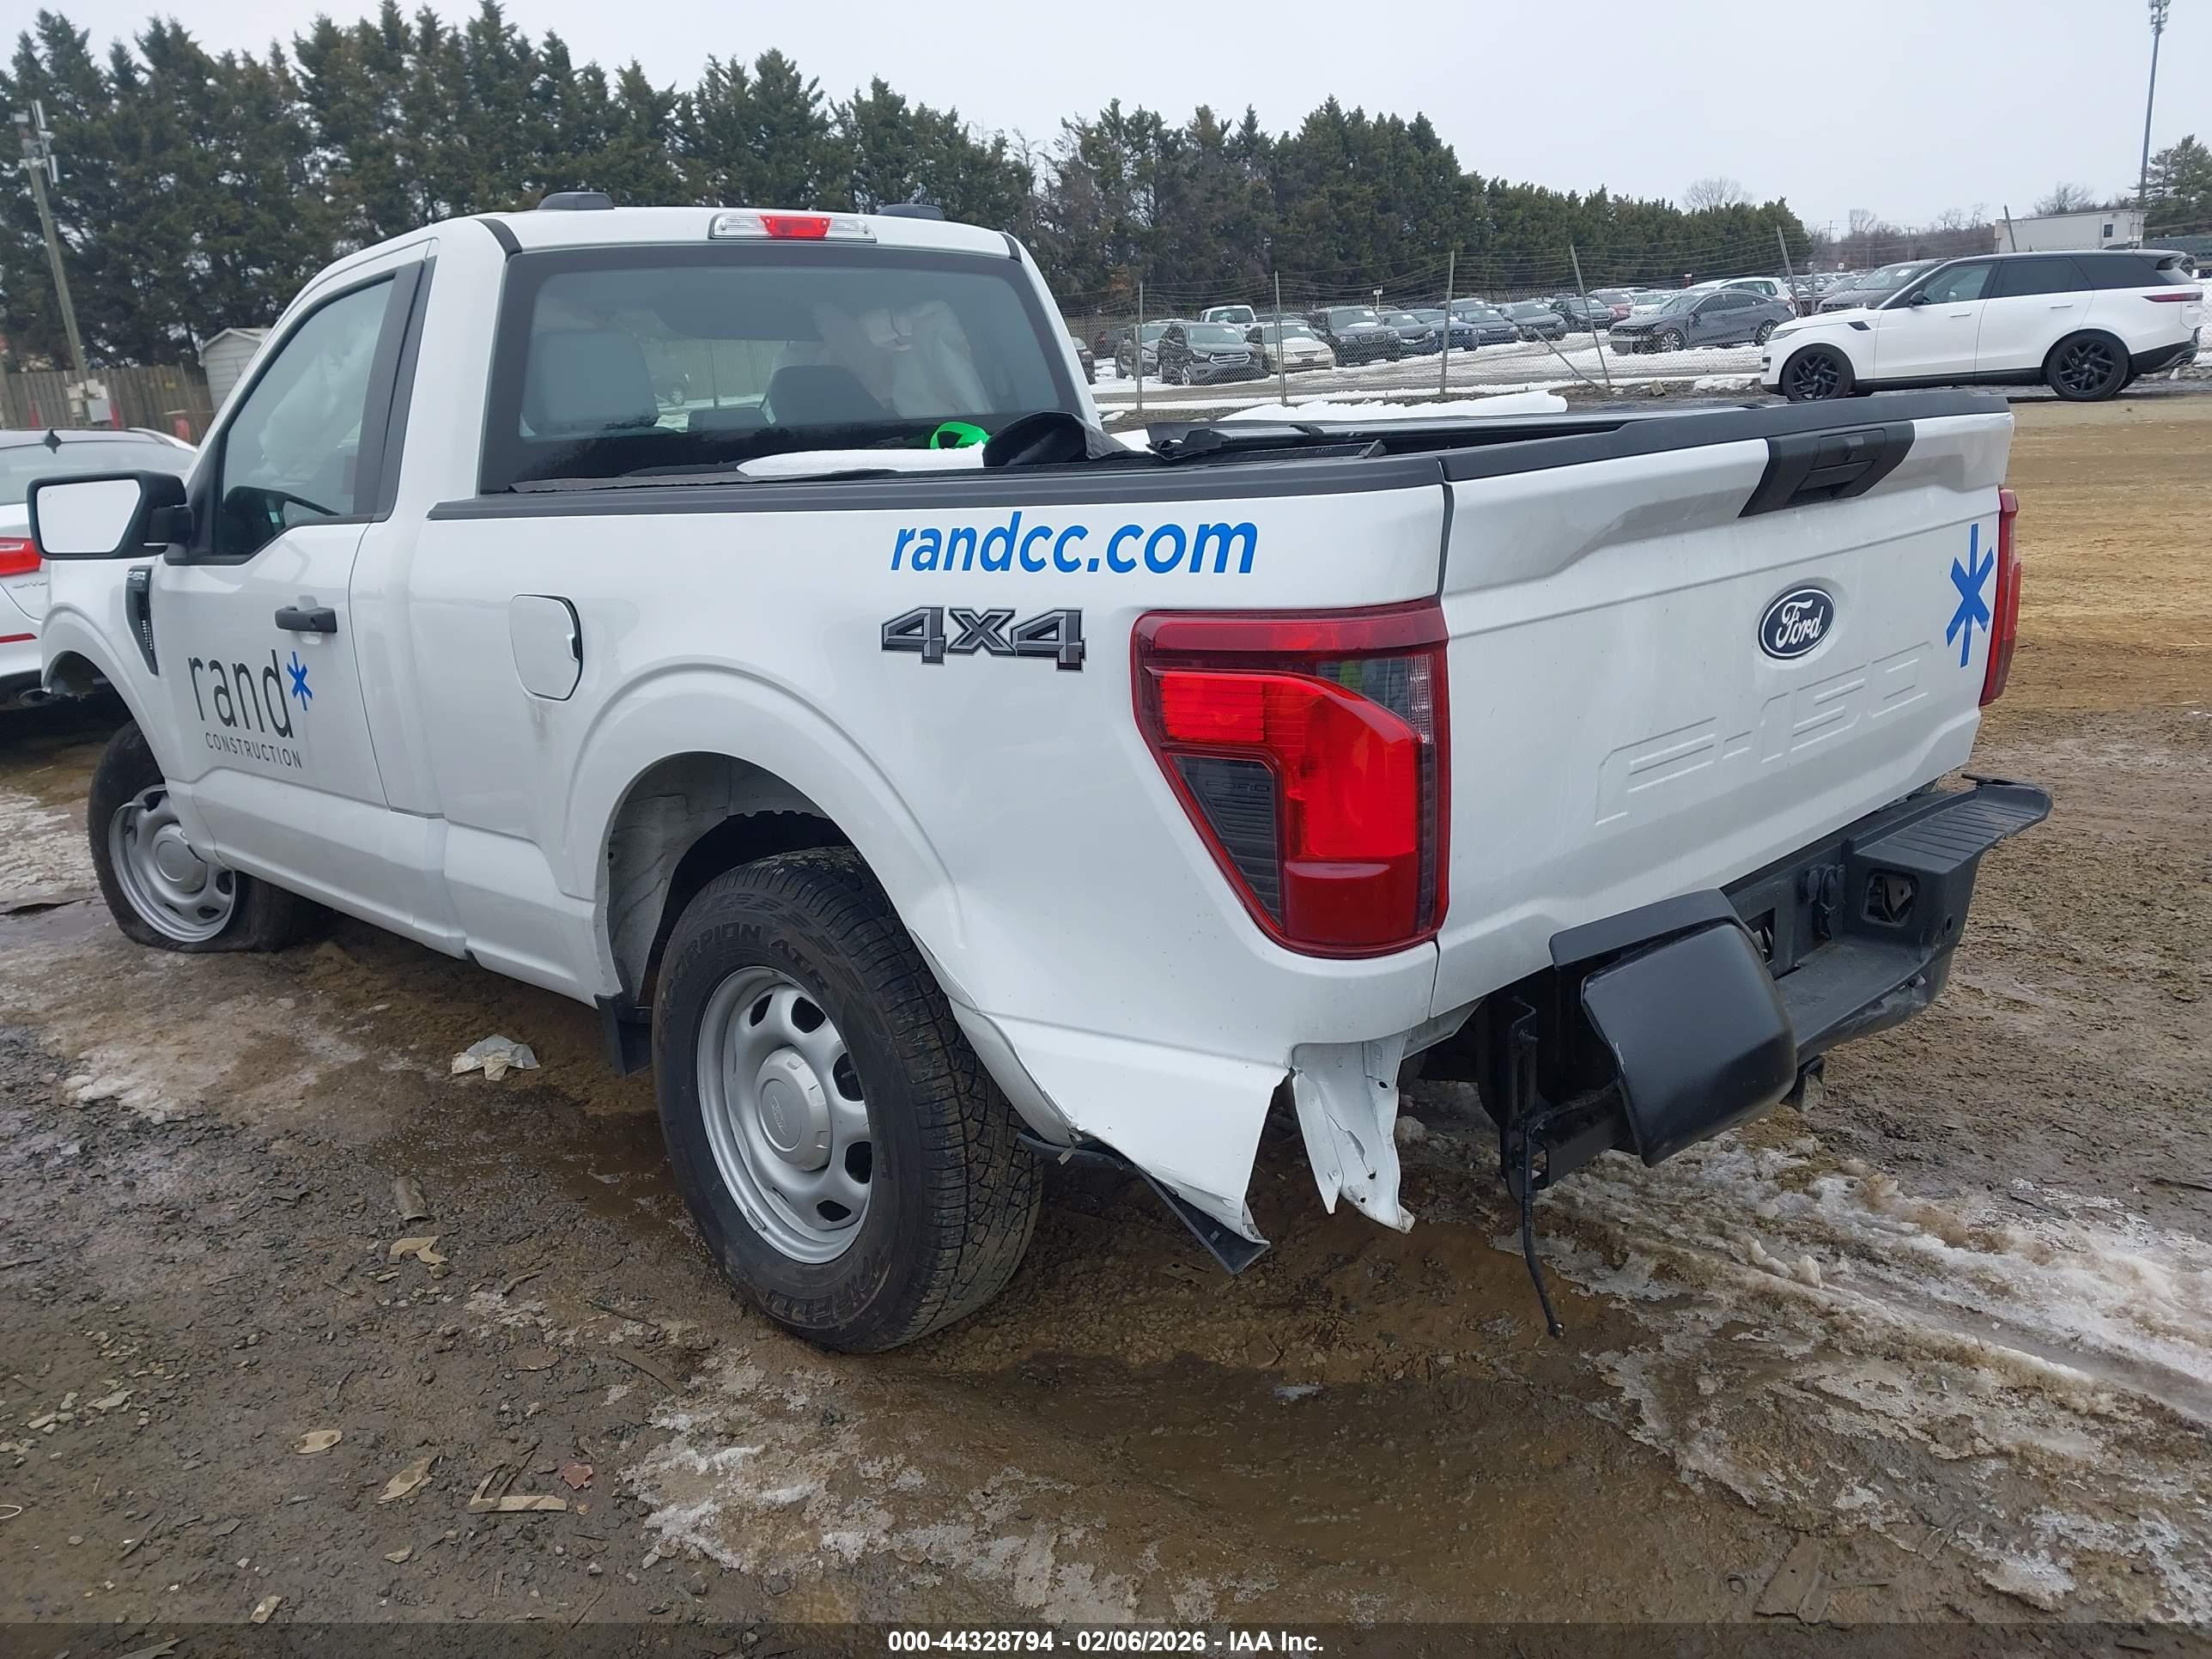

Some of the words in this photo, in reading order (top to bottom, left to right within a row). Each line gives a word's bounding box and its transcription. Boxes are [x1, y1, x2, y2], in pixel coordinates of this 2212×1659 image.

[890, 511, 1258, 574] randcc.com
[1776, 599, 1824, 648] Ford
[205, 732, 302, 769] CONSTRUCTION
